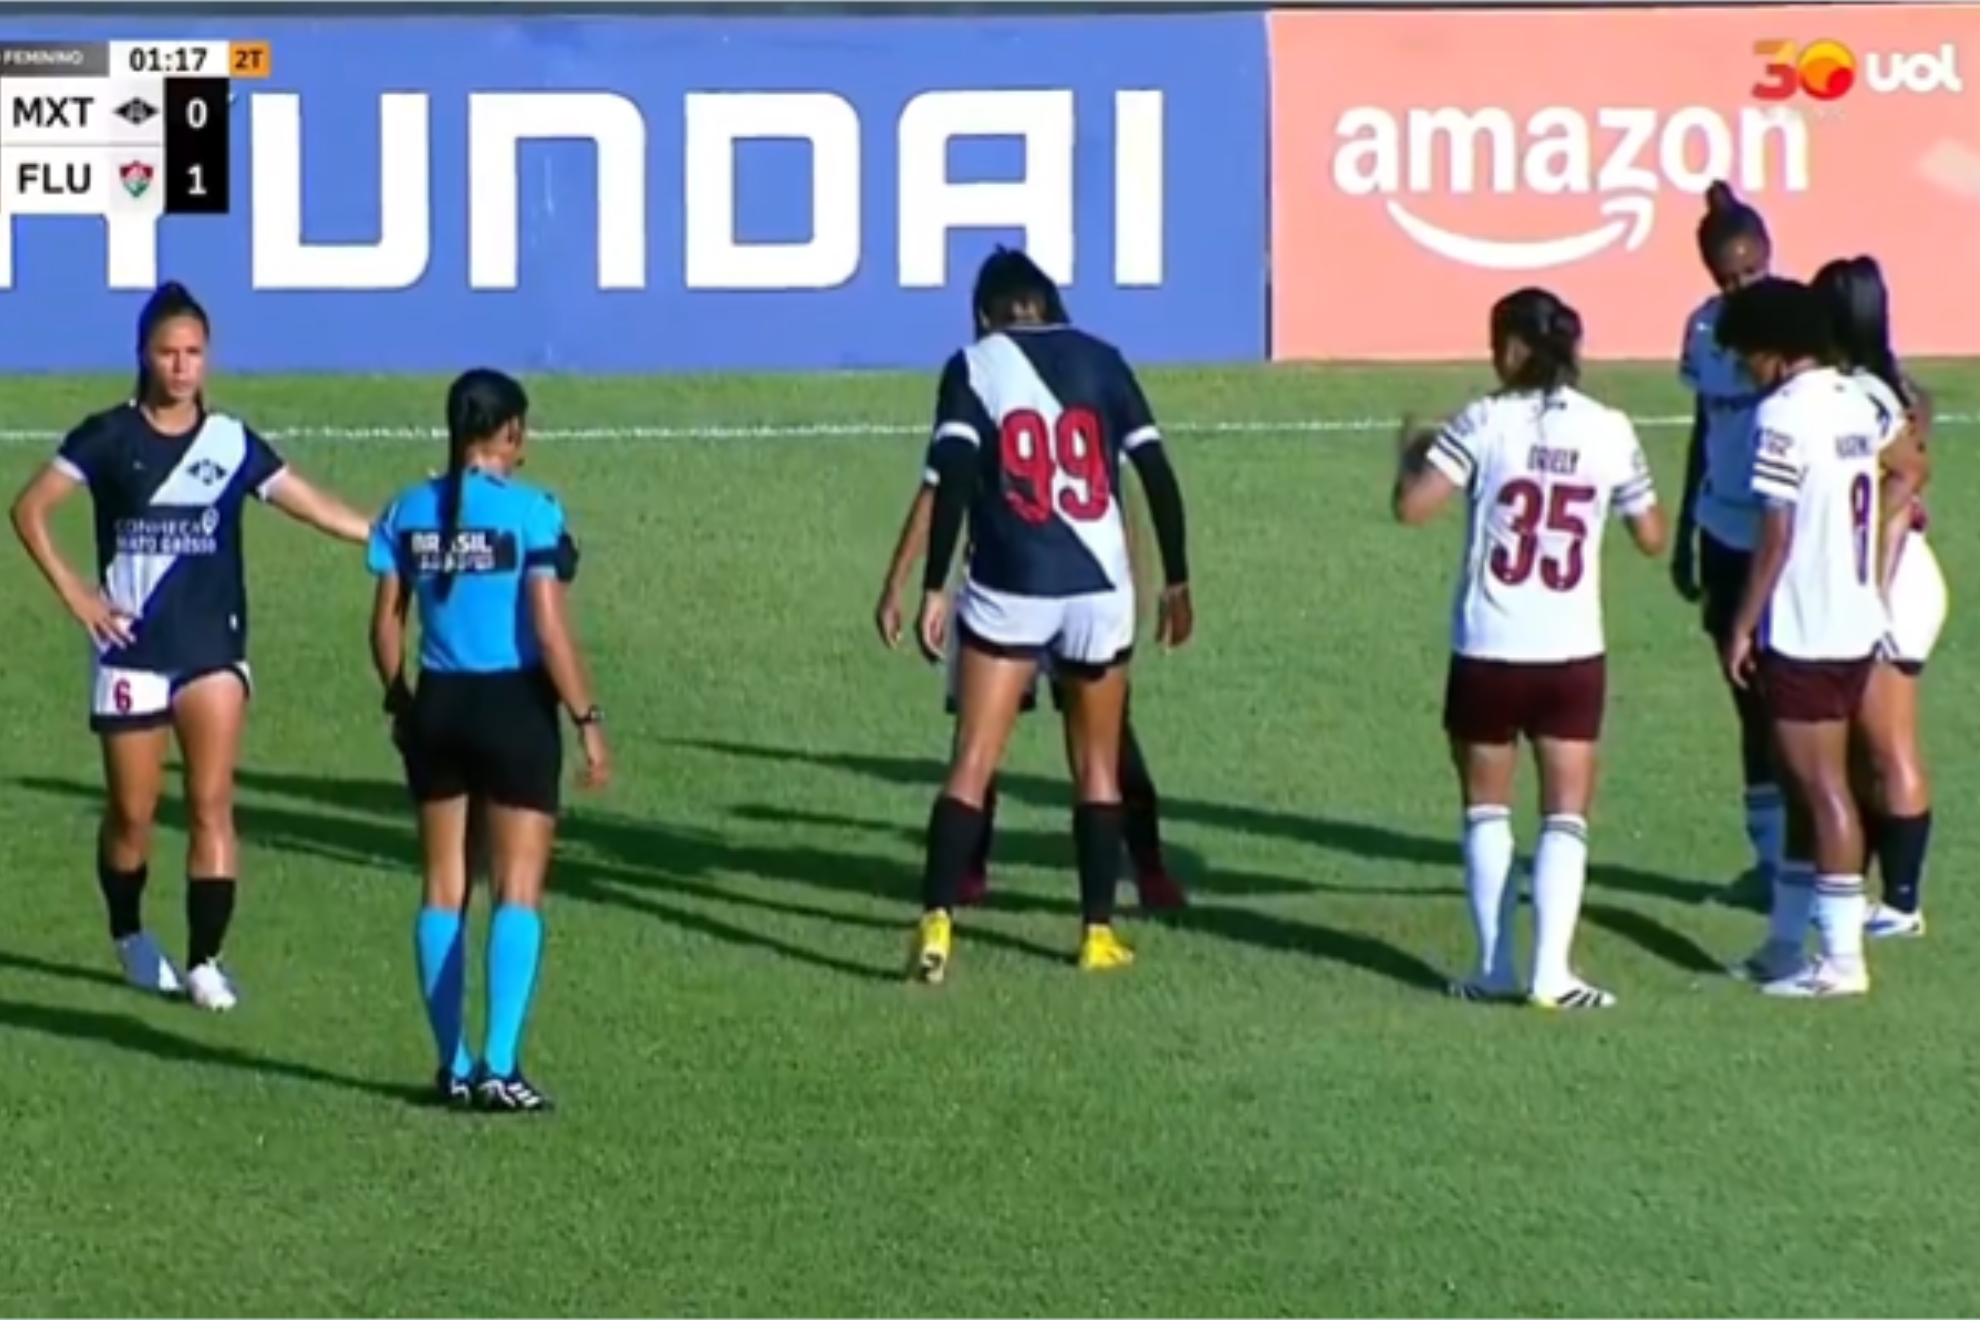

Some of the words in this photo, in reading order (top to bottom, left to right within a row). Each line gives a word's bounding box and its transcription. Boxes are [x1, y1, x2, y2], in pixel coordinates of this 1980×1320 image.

[0, 90, 1163, 290] UNDAI
[1333, 105, 1811, 194] amazon
[1001, 405, 1111, 527] 99
[411, 532, 492, 552] BRSIL
[1490, 478, 1597, 592] 35
[113, 677, 133, 714] 6
